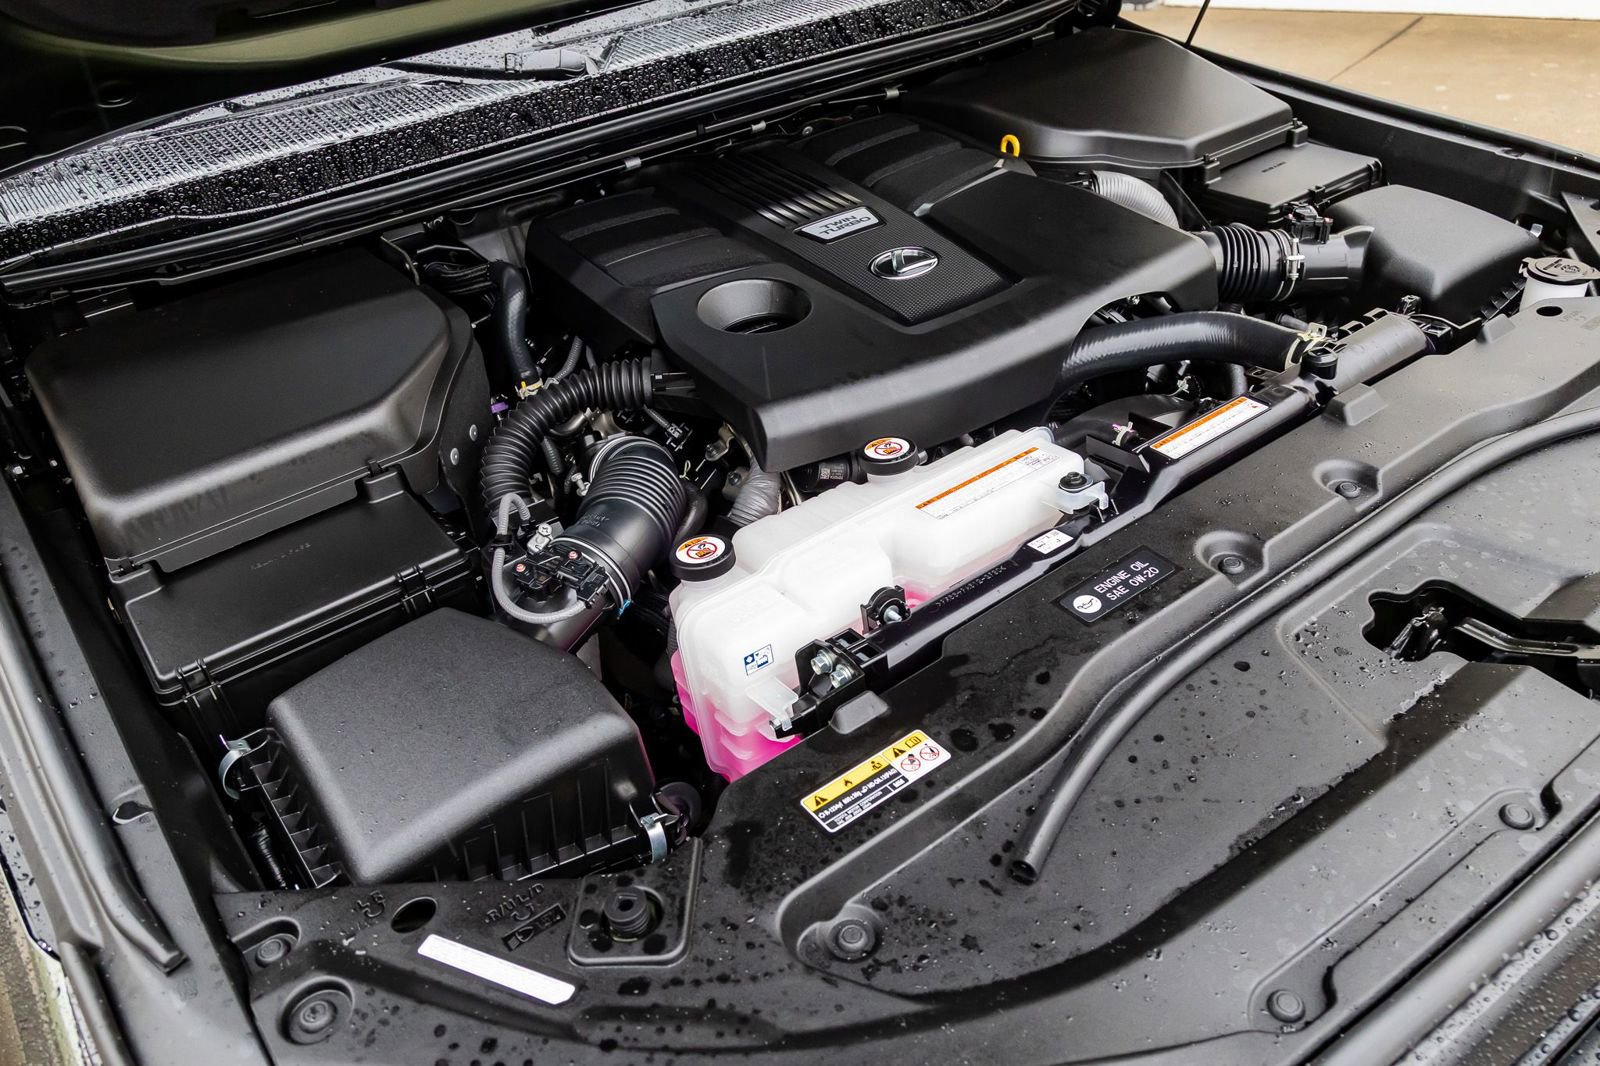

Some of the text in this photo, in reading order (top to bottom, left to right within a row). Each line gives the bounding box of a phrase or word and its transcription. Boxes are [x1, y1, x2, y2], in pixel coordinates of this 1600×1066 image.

[819, 216, 872, 235] TURBO
[820, 215, 857, 229] TWIN
[1093, 560, 1150, 594] ENGINE OIL
[1106, 566, 1160, 601] SAE 0W-20
